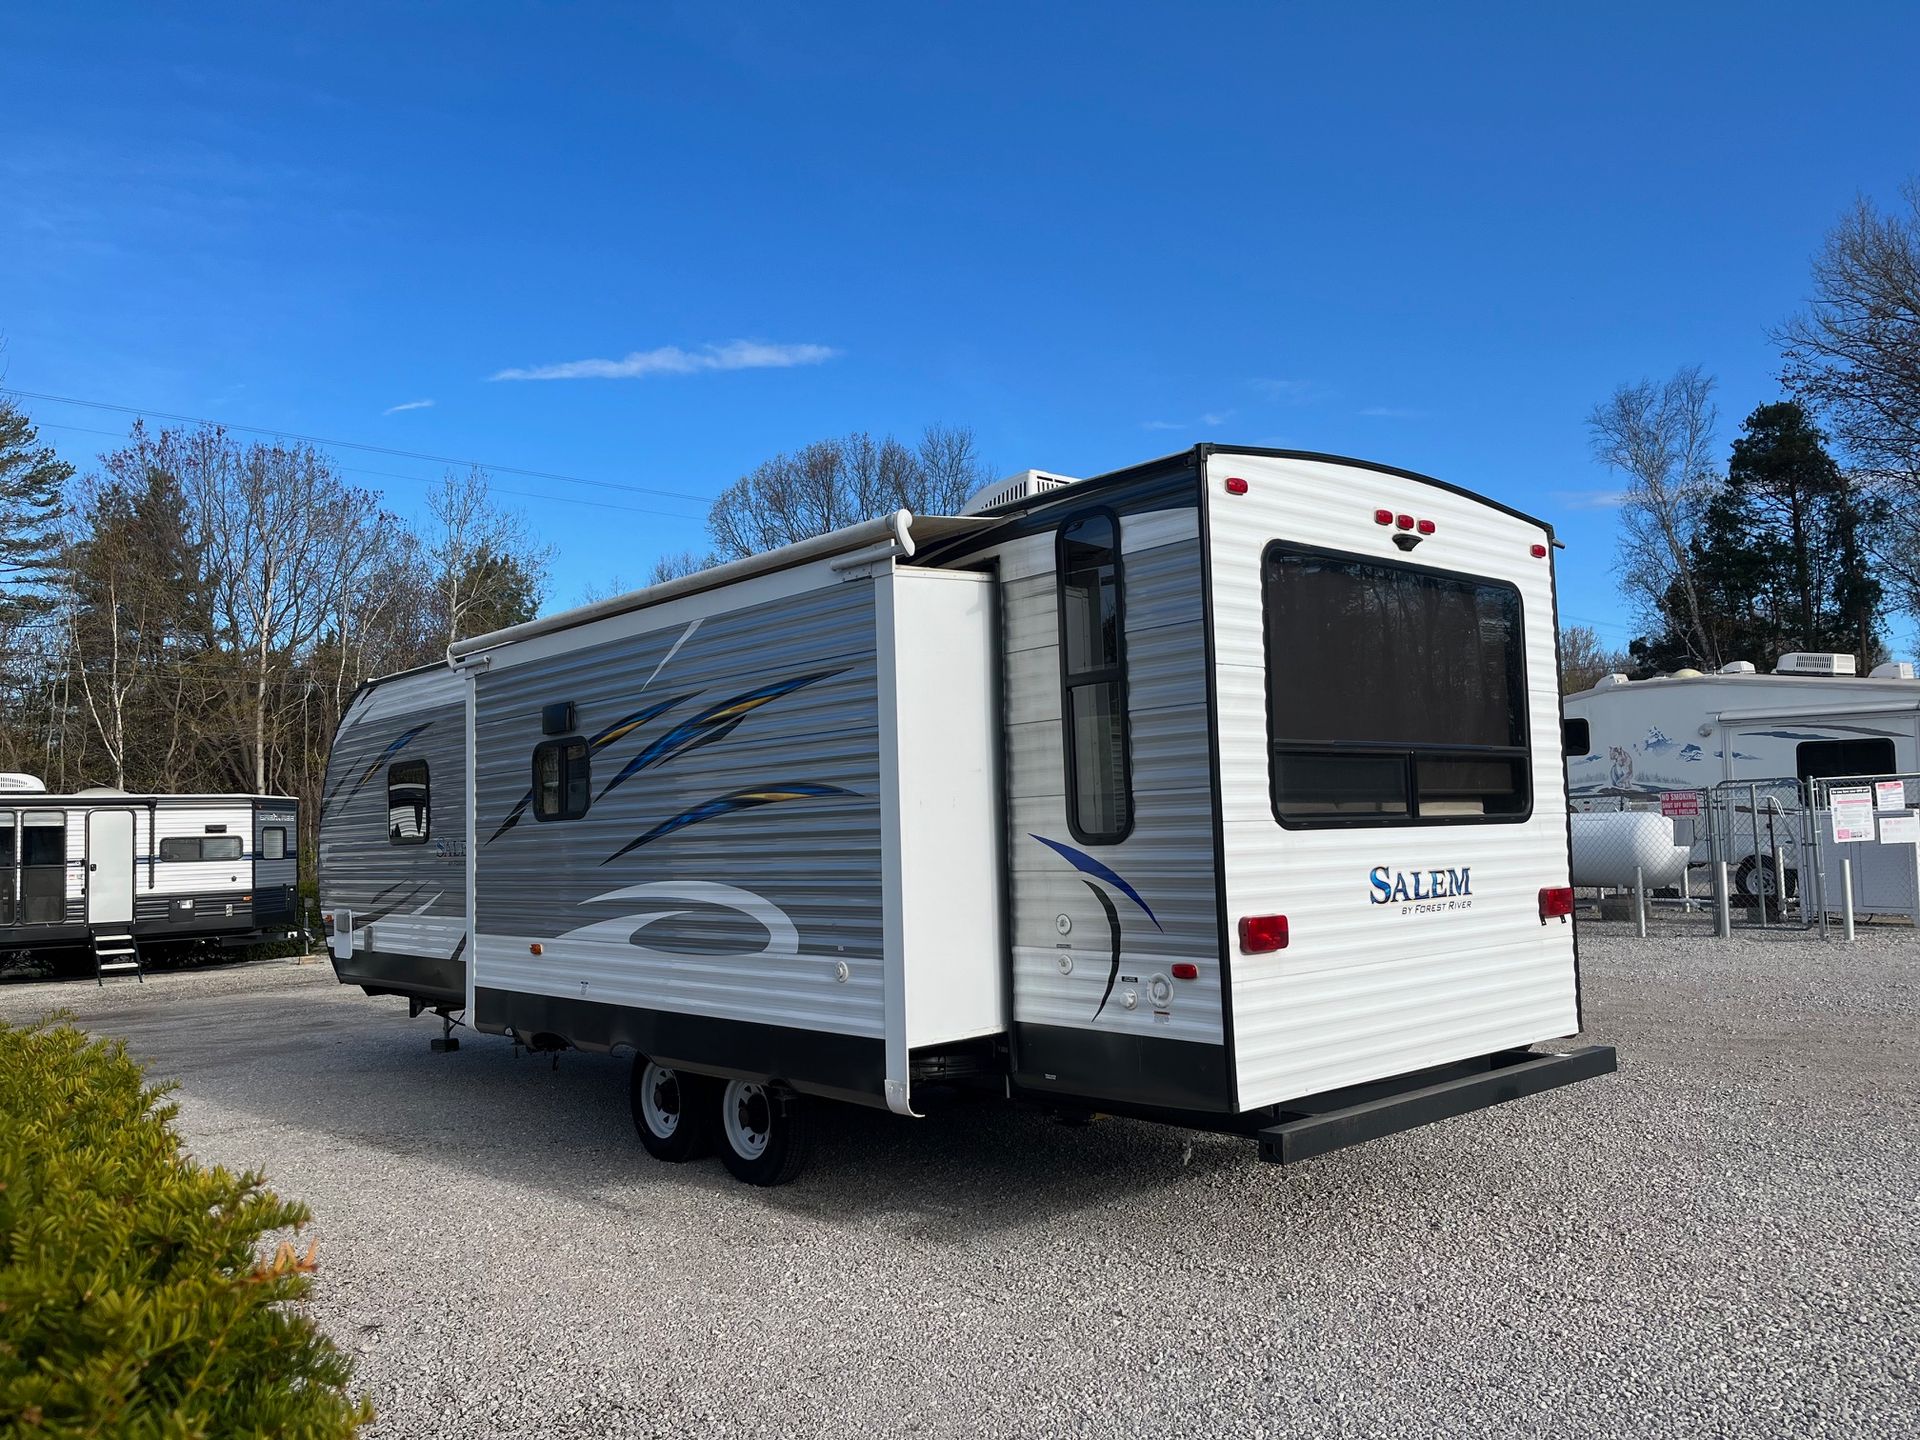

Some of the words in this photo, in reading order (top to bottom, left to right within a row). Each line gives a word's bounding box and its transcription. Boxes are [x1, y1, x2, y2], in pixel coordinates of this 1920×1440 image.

[1661, 793, 1670, 801] NO
[1670, 792, 1696, 800] SMOKING
[436, 836, 466, 858] SALE
[1370, 866, 1472, 904] SALEM
[1402, 906, 1413, 914] BY
[1415, 904, 1446, 914] FOREST
[1448, 900, 1472, 910] RIVER
